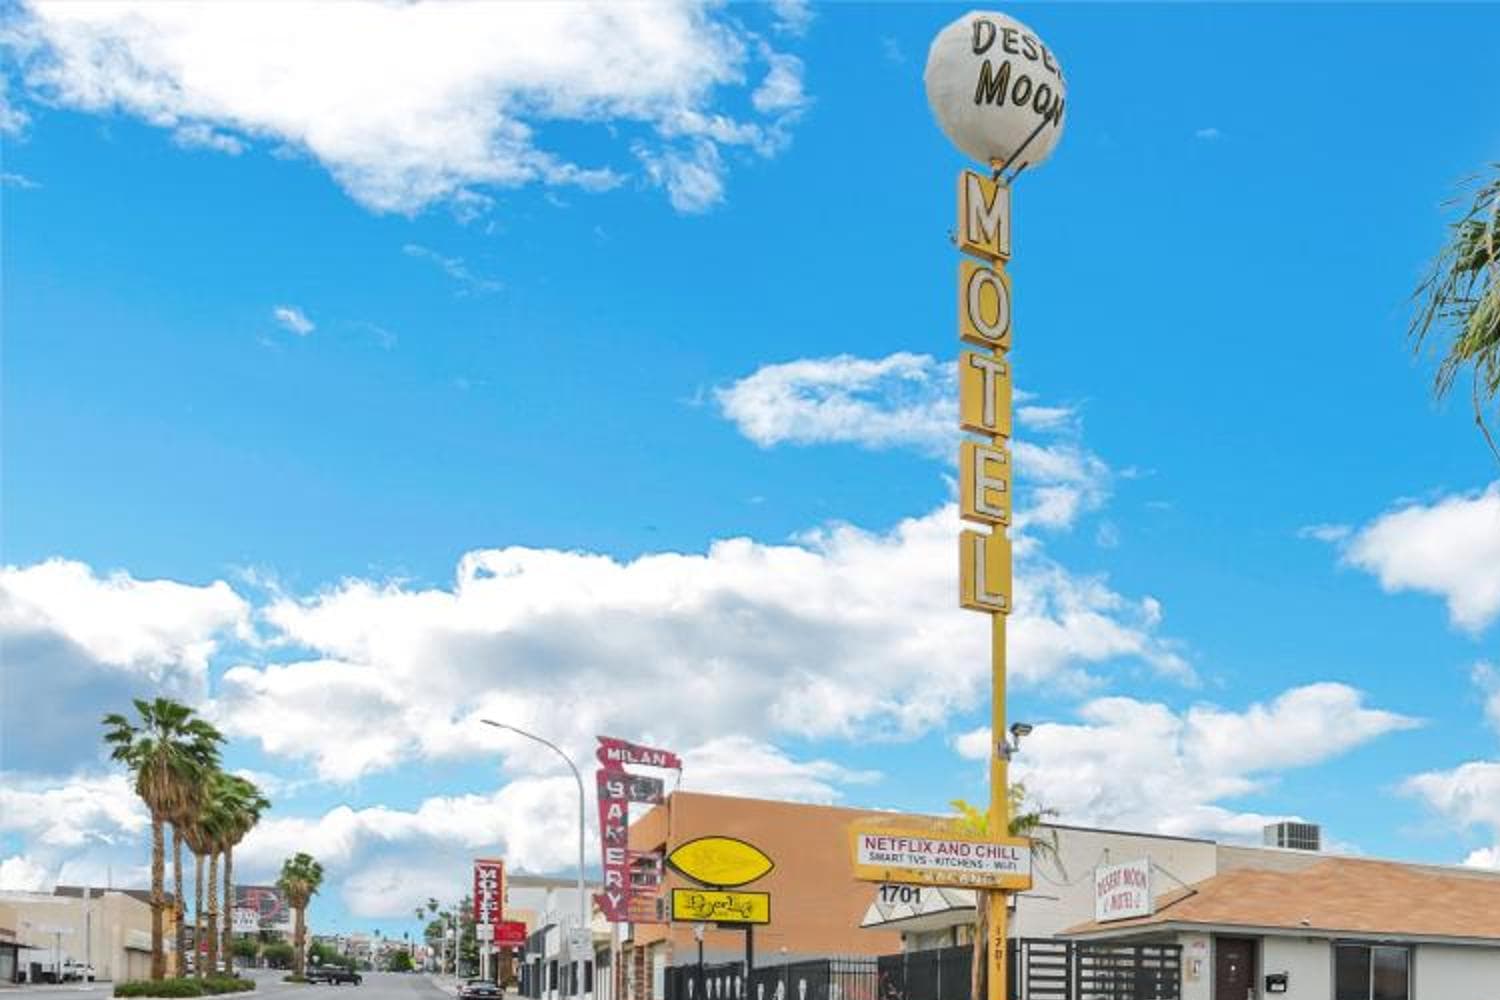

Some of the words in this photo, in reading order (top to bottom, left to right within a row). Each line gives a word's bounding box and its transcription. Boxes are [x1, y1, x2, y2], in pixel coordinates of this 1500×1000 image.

[972, 20, 1062, 80] DESE
[974, 59, 1065, 128] MOON
[965, 170, 1011, 609] MOTEL
[607, 748, 667, 766] MILAN
[605, 780, 625, 909] BAKERY
[865, 837, 932, 853] NETFLIX
[937, 842, 971, 857] AND
[975, 845, 1020, 861] CHILL
[869, 852, 904, 862] SMART
[935, 857, 983, 869] KITCHENS
[478, 868, 499, 924] MOTEL
[880, 885, 921, 904] 1701
